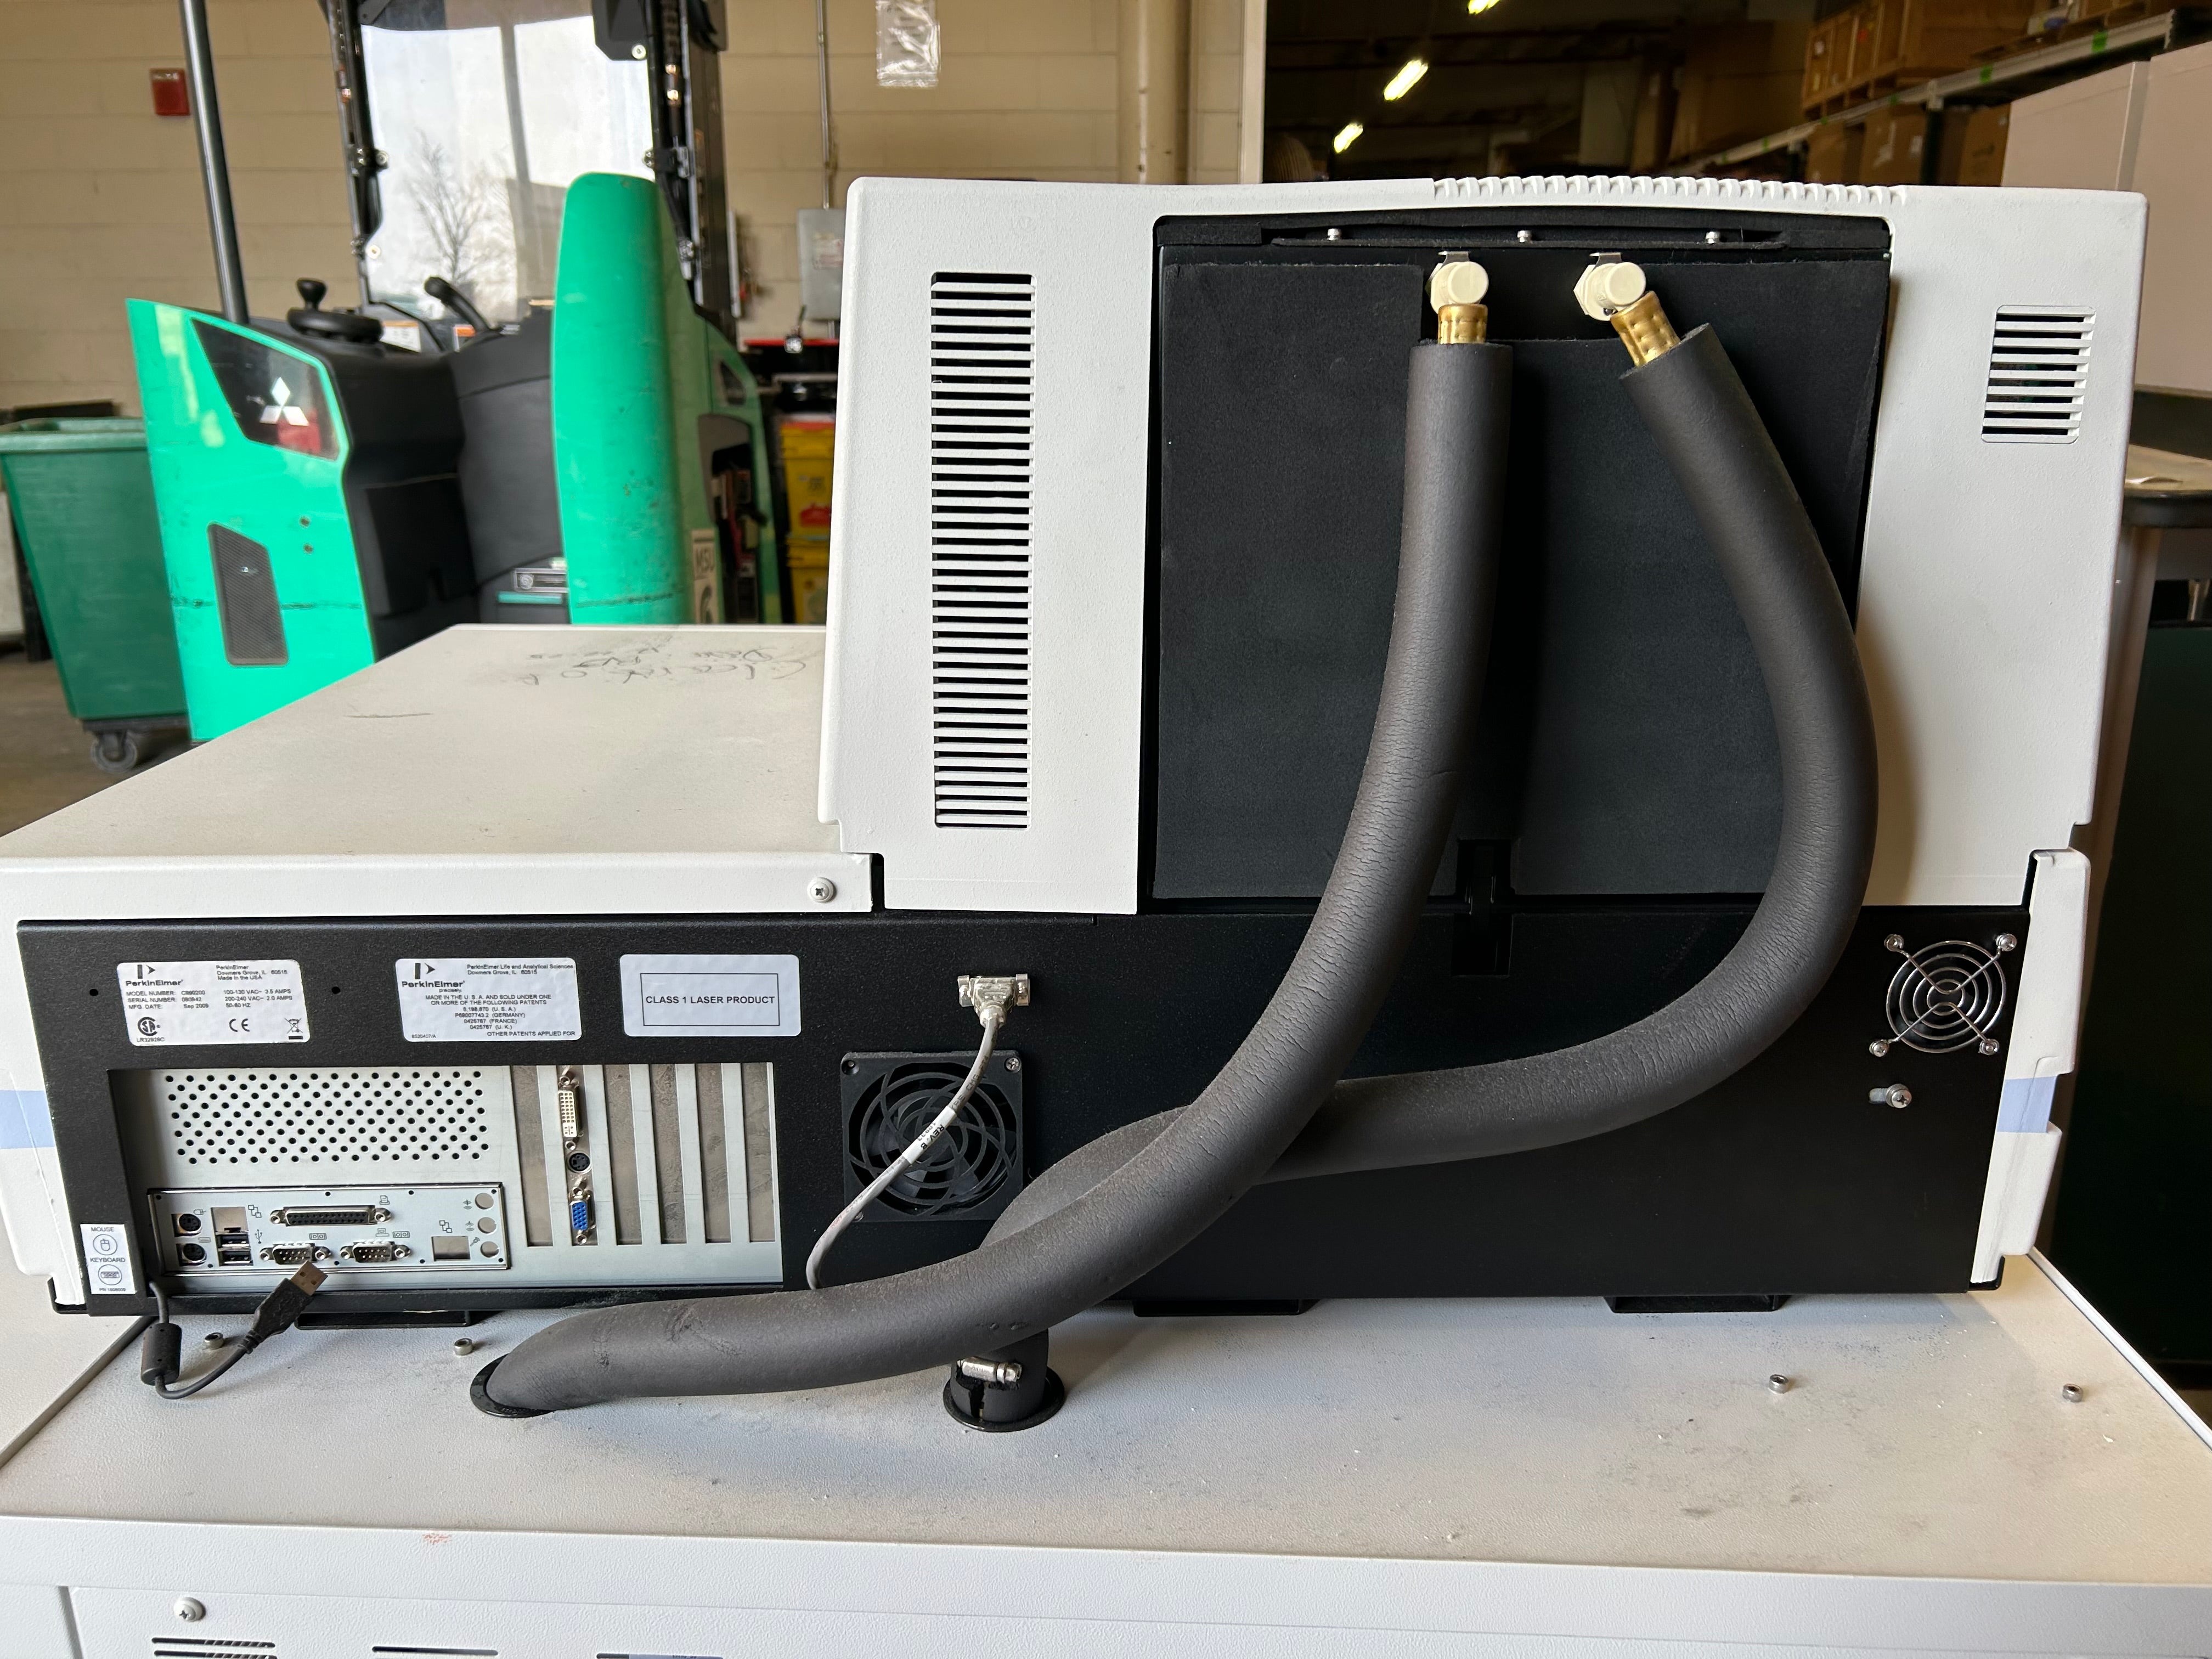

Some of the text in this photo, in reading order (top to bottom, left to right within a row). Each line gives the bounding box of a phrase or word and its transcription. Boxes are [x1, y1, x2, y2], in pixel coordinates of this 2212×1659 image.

[646, 996, 775, 1004] CLASS 1 LASER PRODUCT
[229, 1018, 250, 1032] CE
[927, 1124, 944, 1142] REV.
